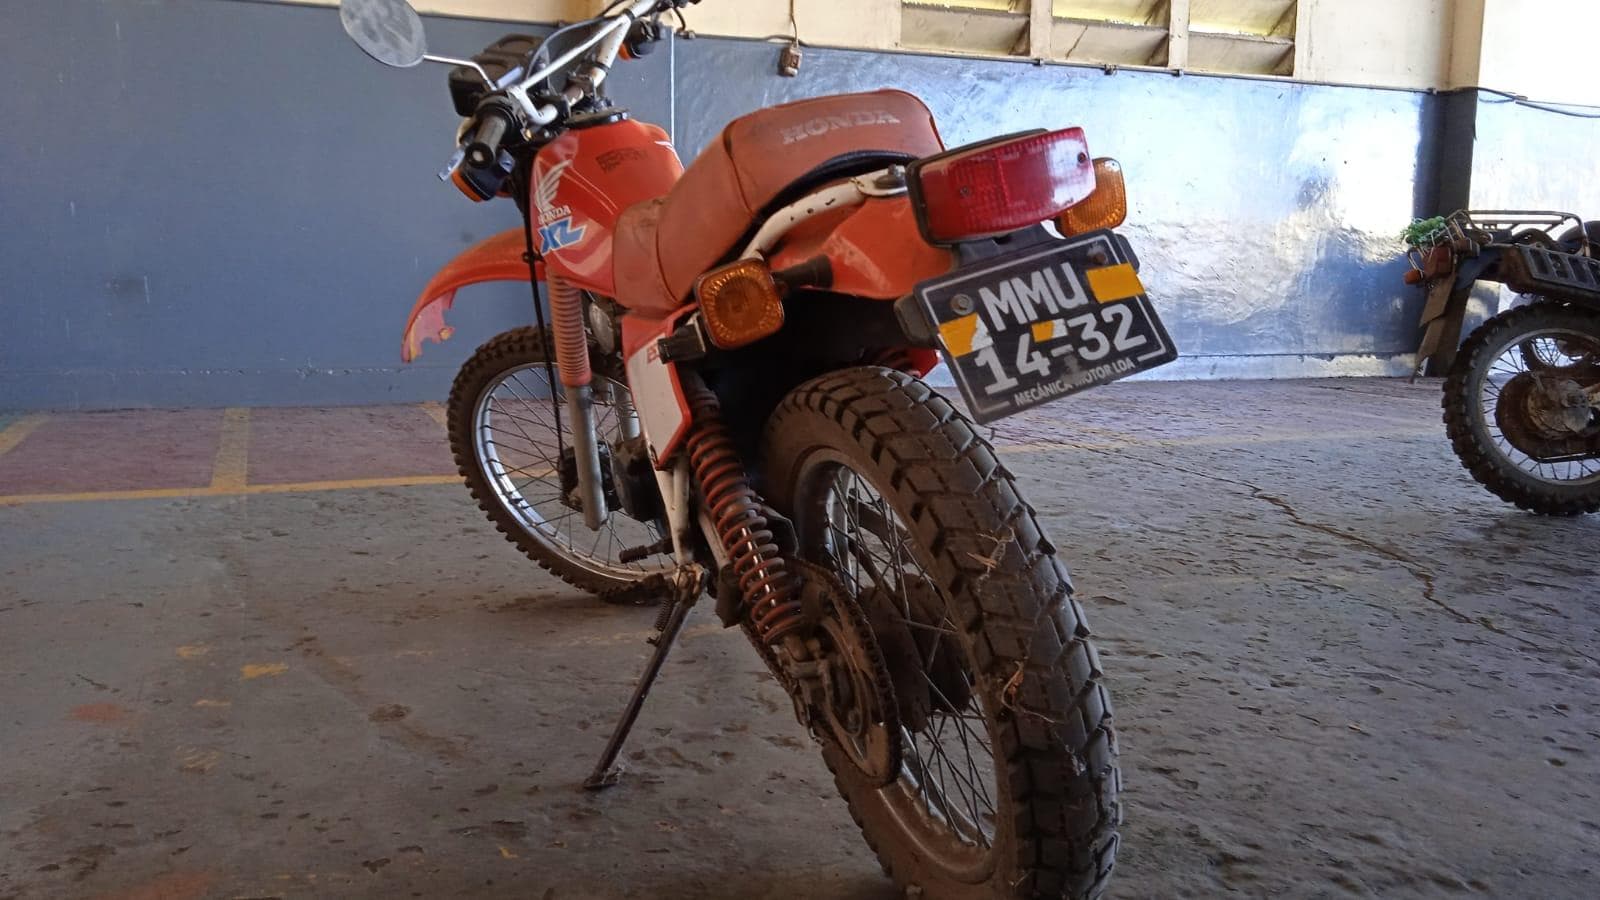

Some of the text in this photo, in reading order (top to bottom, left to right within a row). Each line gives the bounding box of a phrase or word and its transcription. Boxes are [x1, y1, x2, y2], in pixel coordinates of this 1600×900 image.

[780, 110, 900, 145] HONDA
[538, 205, 571, 225] HONDA
[538, 216, 587, 256] XL
[979, 262, 1089, 332] MMU
[974, 303, 1147, 395] 14-32
